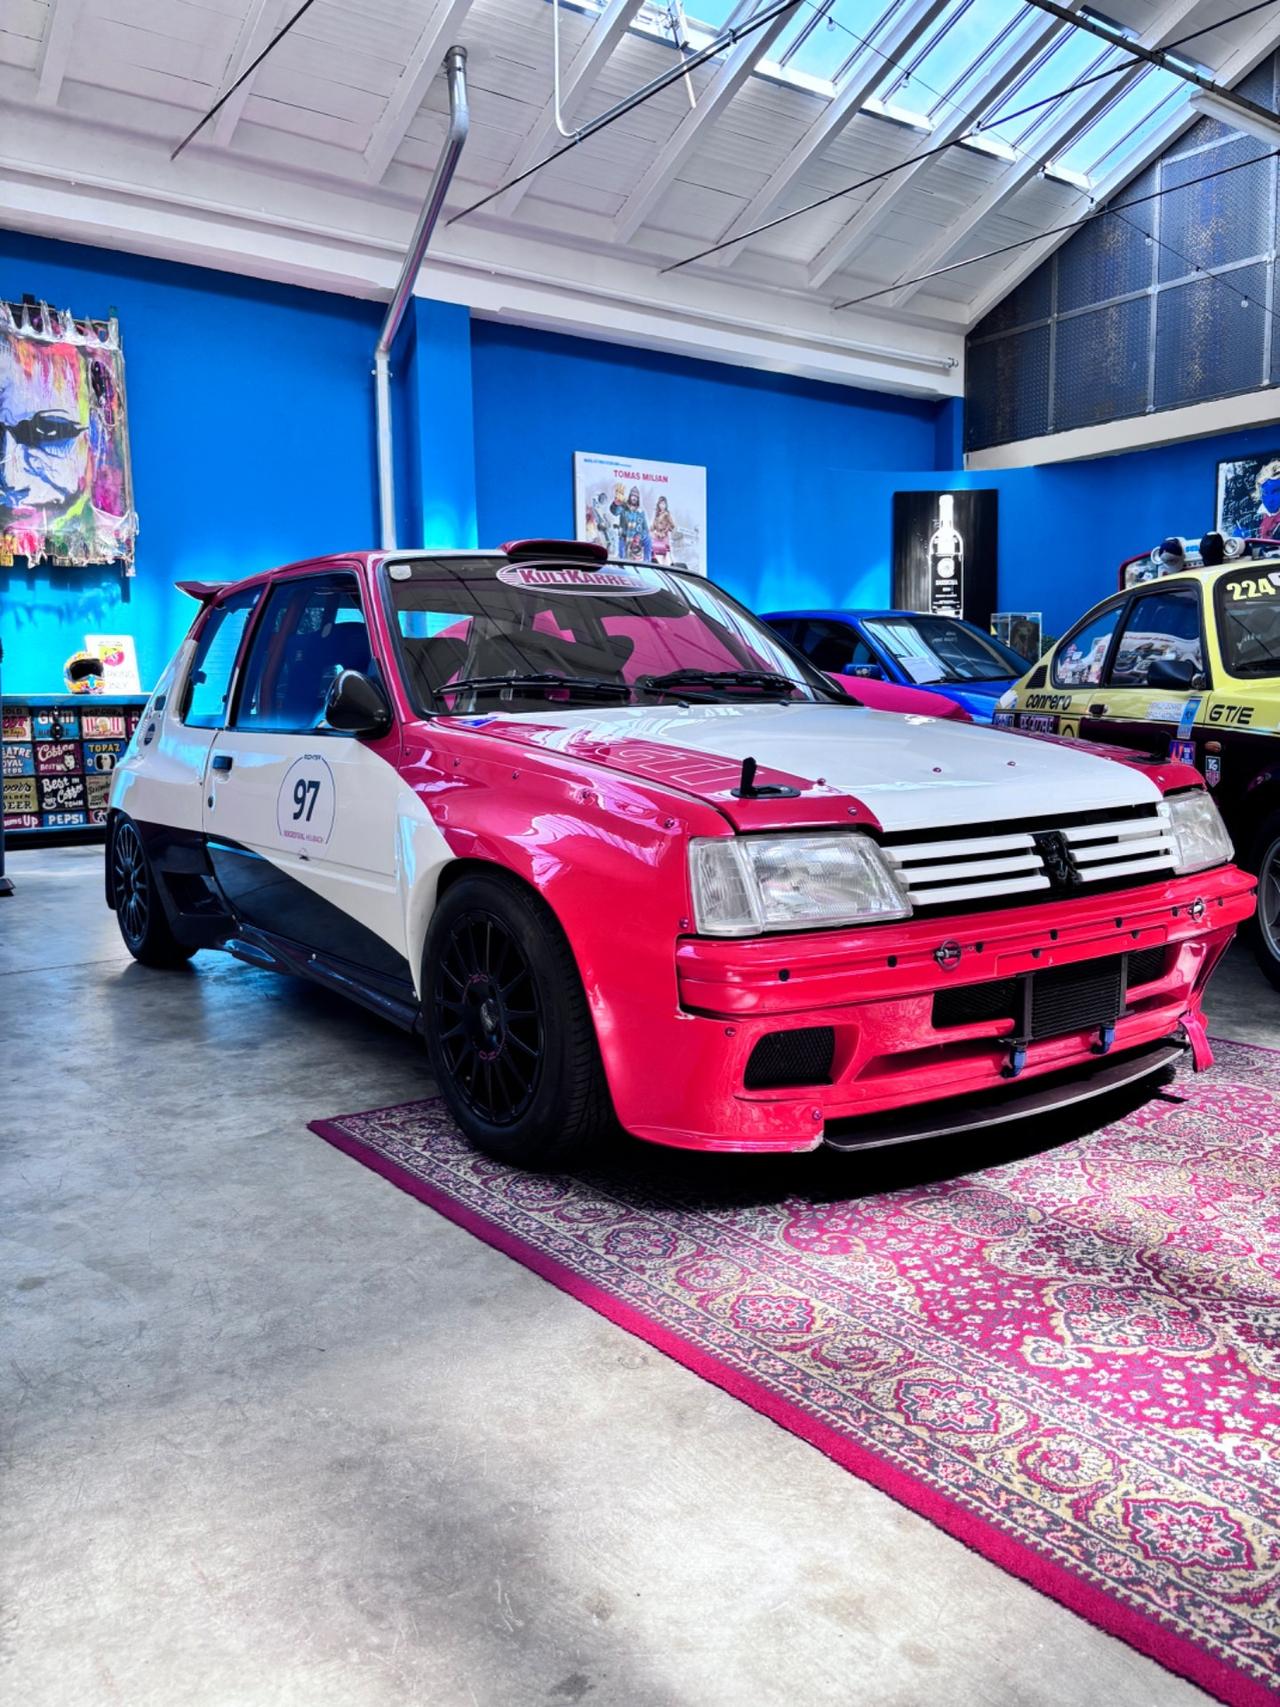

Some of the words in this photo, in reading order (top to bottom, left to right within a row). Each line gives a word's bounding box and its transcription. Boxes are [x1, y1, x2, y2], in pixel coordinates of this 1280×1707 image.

[613, 470, 640, 480] TOMAS
[642, 473, 669, 483] MILIAN
[1226, 578, 1276, 600] 224
[1025, 694, 1072, 711] conrero
[1209, 704, 1254, 724] GT/E
[88, 744, 121, 752] TOPAZ
[42, 776, 70, 793] Best
[292, 778, 321, 822] 97
[48, 814, 84, 825] PEPSI
